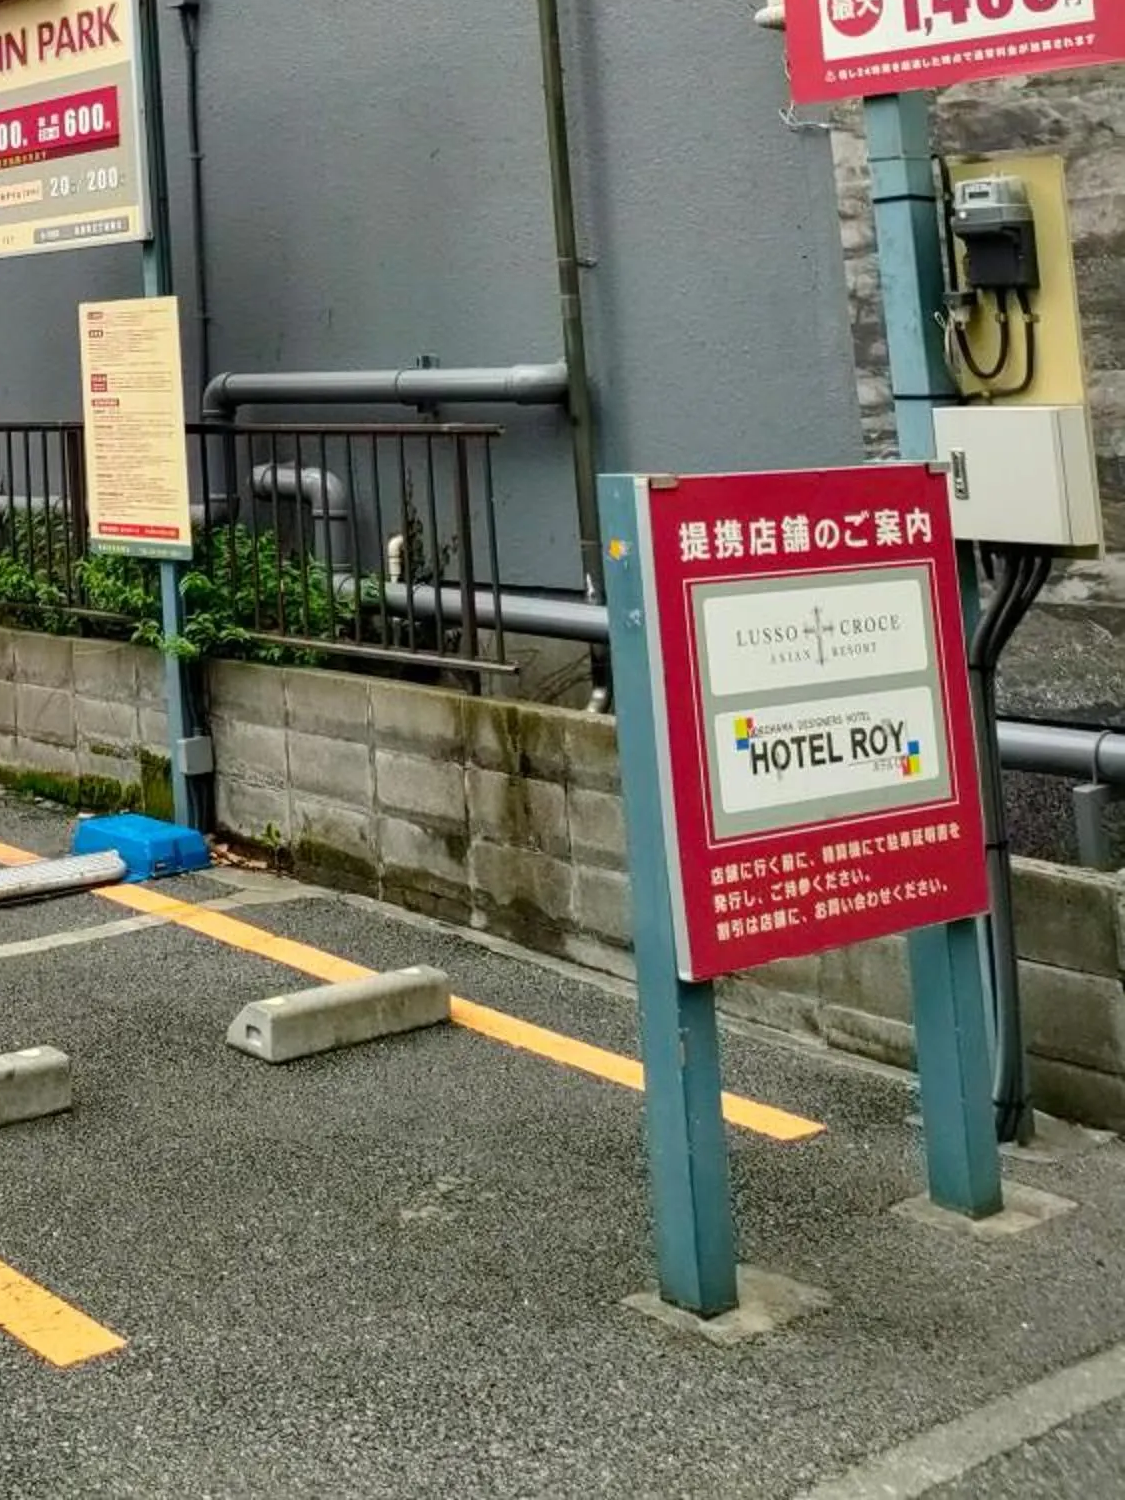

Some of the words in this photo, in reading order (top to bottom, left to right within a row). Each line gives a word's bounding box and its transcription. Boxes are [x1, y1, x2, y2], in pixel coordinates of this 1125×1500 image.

[37, 2, 120, 61] PARK
[679, 508, 933, 562] 提携店舗のご案内
[736, 625, 799, 647] LUSSO
[840, 613, 902, 636] CROCE
[749, 732, 843, 775] HOTEL
[850, 720, 904, 759] ROY
